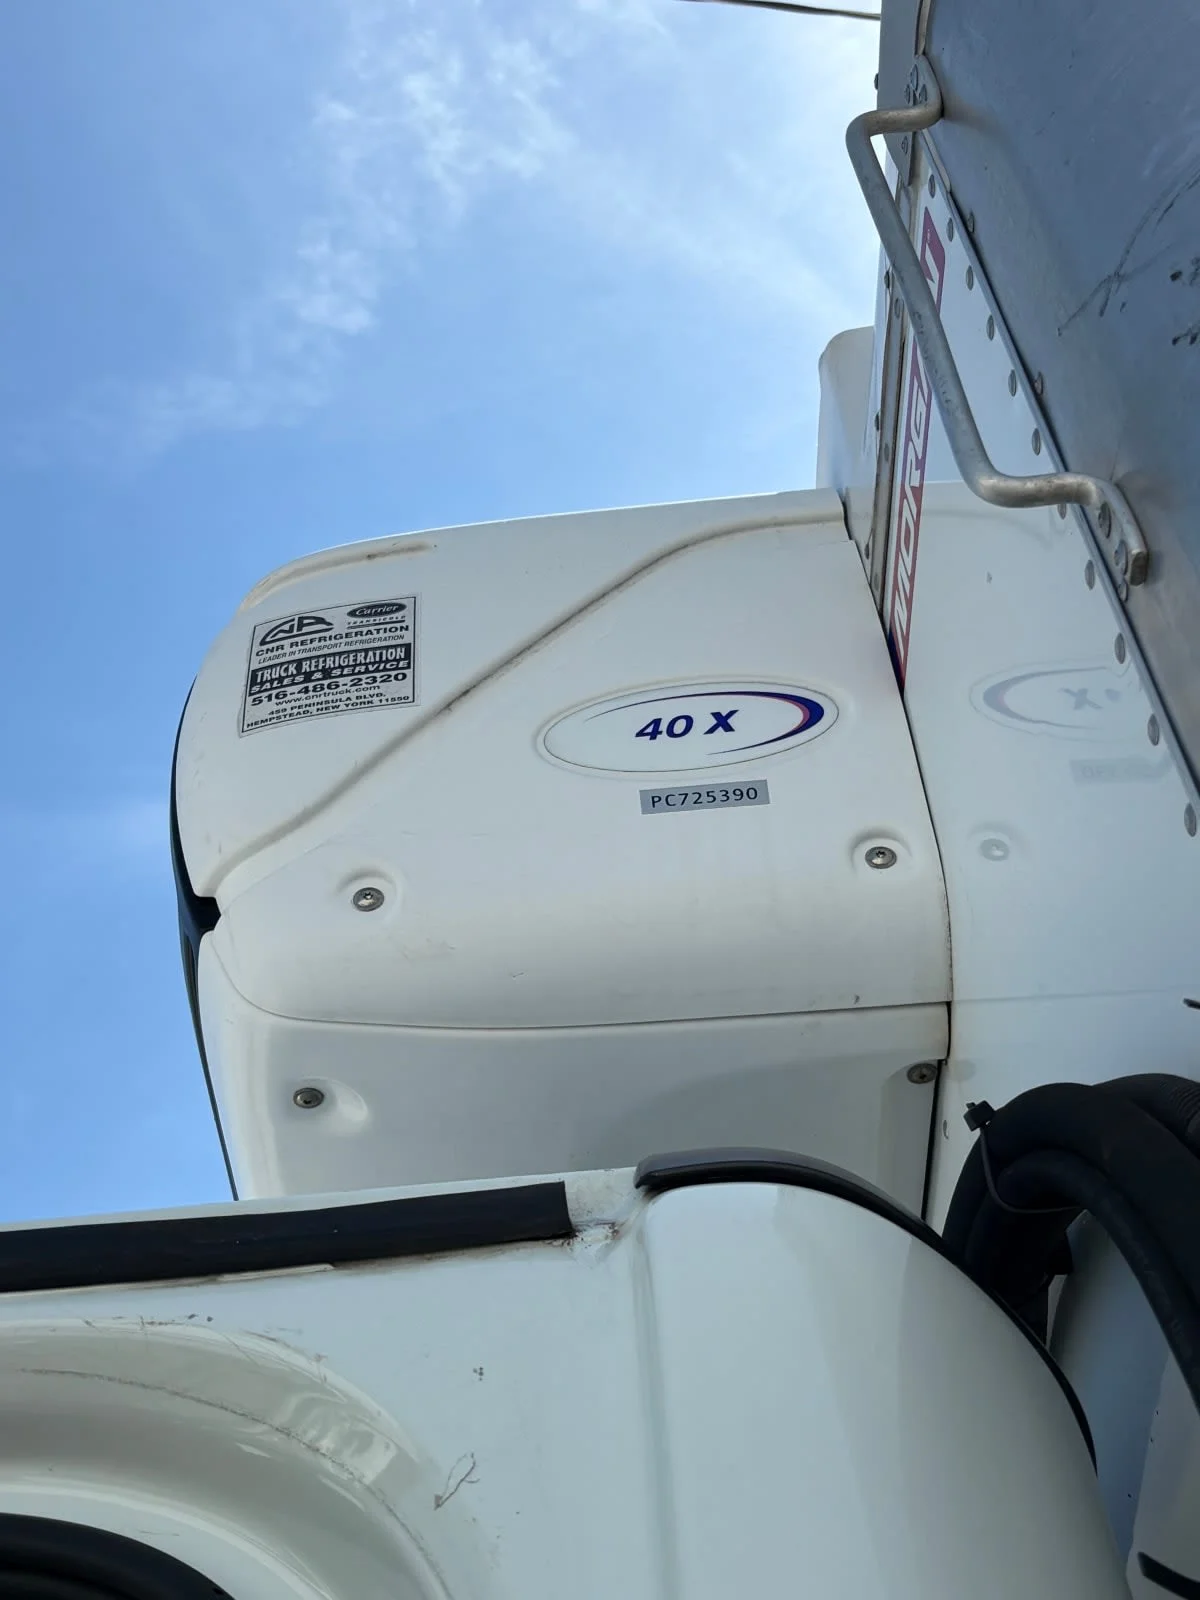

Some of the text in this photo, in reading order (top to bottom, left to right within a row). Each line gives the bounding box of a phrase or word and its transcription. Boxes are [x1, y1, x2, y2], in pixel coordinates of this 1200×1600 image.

[895, 243, 940, 664] MORGN
[355, 605, 399, 615] Carrier
[256, 625, 409, 657] CNR REFRIGERATION
[258, 653, 287, 665] LEADER
[297, 642, 342, 655] TRANSPORT
[344, 634, 404, 647] REFRIGERATION
[251, 675, 304, 693] SALES
[331, 660, 409, 676] SERVICE
[256, 647, 405, 682] TRUCK REFRIGERATION
[251, 672, 407, 706] 516-486-2320
[275, 685, 380, 706] www.cnrtruck.com
[291, 697, 352, 711] PENINSULA
[356, 692, 386, 700] BLVD.
[247, 695, 409, 728] HEMPSTEAD, NEW YORK 11550
[635, 709, 739, 740] 40 X
[651, 787, 758, 808] PC725390
